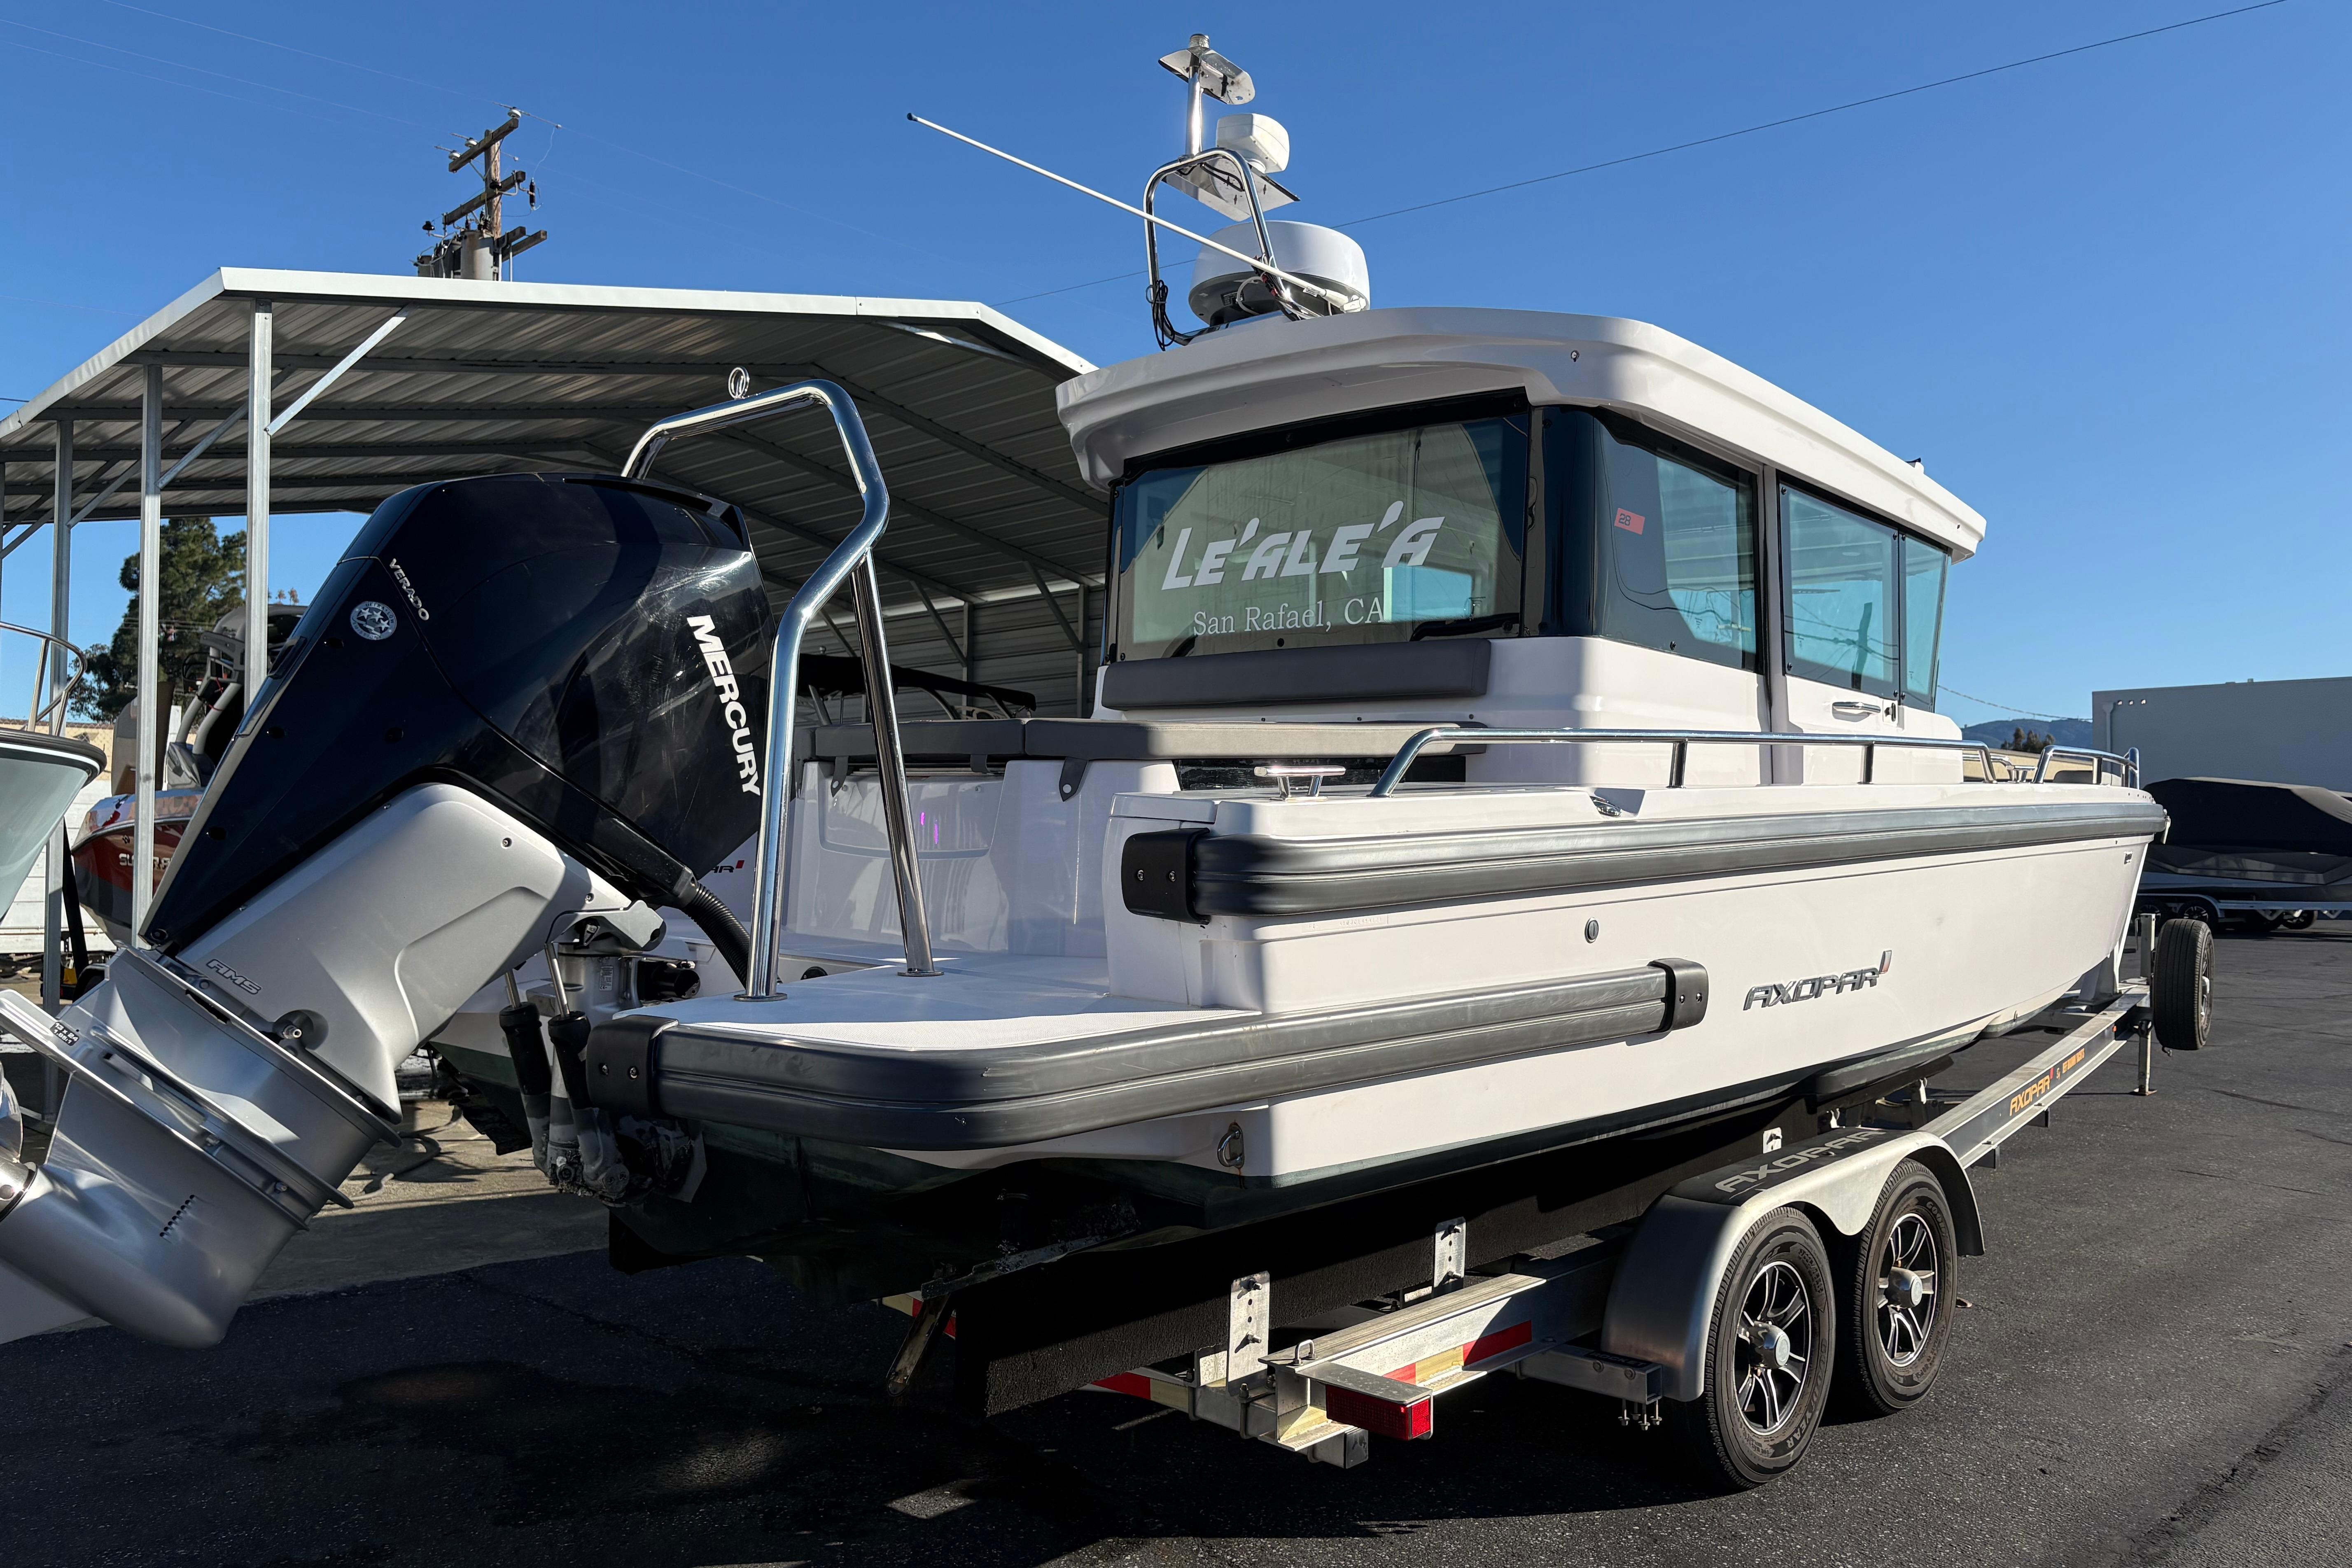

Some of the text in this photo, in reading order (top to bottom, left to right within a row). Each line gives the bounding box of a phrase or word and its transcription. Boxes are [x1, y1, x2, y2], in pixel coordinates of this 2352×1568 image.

[1619, 513, 1631, 526] 28
[390, 558, 429, 621] VERADO
[1193, 597, 1385, 636] San Rafael, CA
[687, 615, 761, 796] MERCURY
[206, 959, 262, 995] AMS
[1743, 967, 1880, 1011] AXOPAR
[2010, 1075, 2050, 1116] AXOPAR
[1715, 1131, 1886, 1193] AXOPAR
